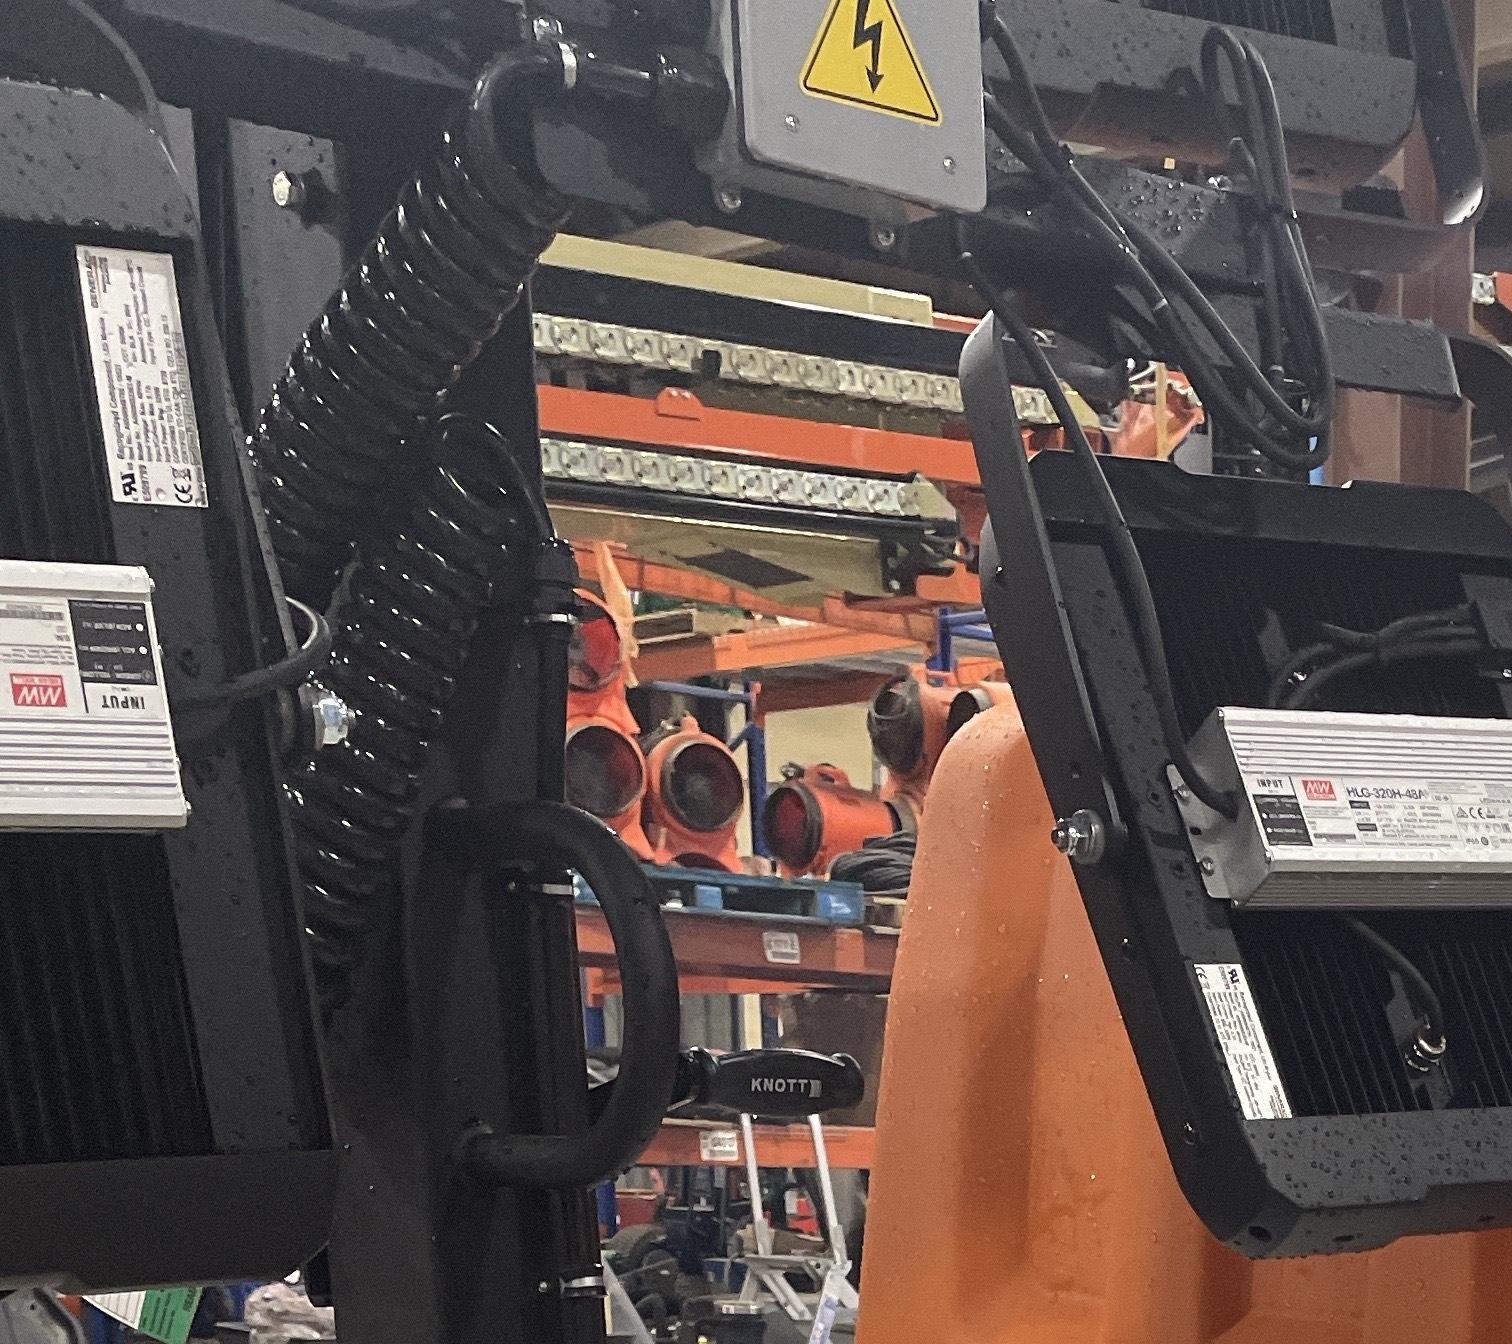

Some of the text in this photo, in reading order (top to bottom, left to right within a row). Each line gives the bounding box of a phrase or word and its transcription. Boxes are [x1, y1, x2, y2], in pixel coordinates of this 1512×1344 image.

[16, 686, 61, 706] MW
[101, 695, 145, 710] INPUT
[1256, 778, 1283, 789] INPUT
[751, 1078, 808, 1092] KNOTT
